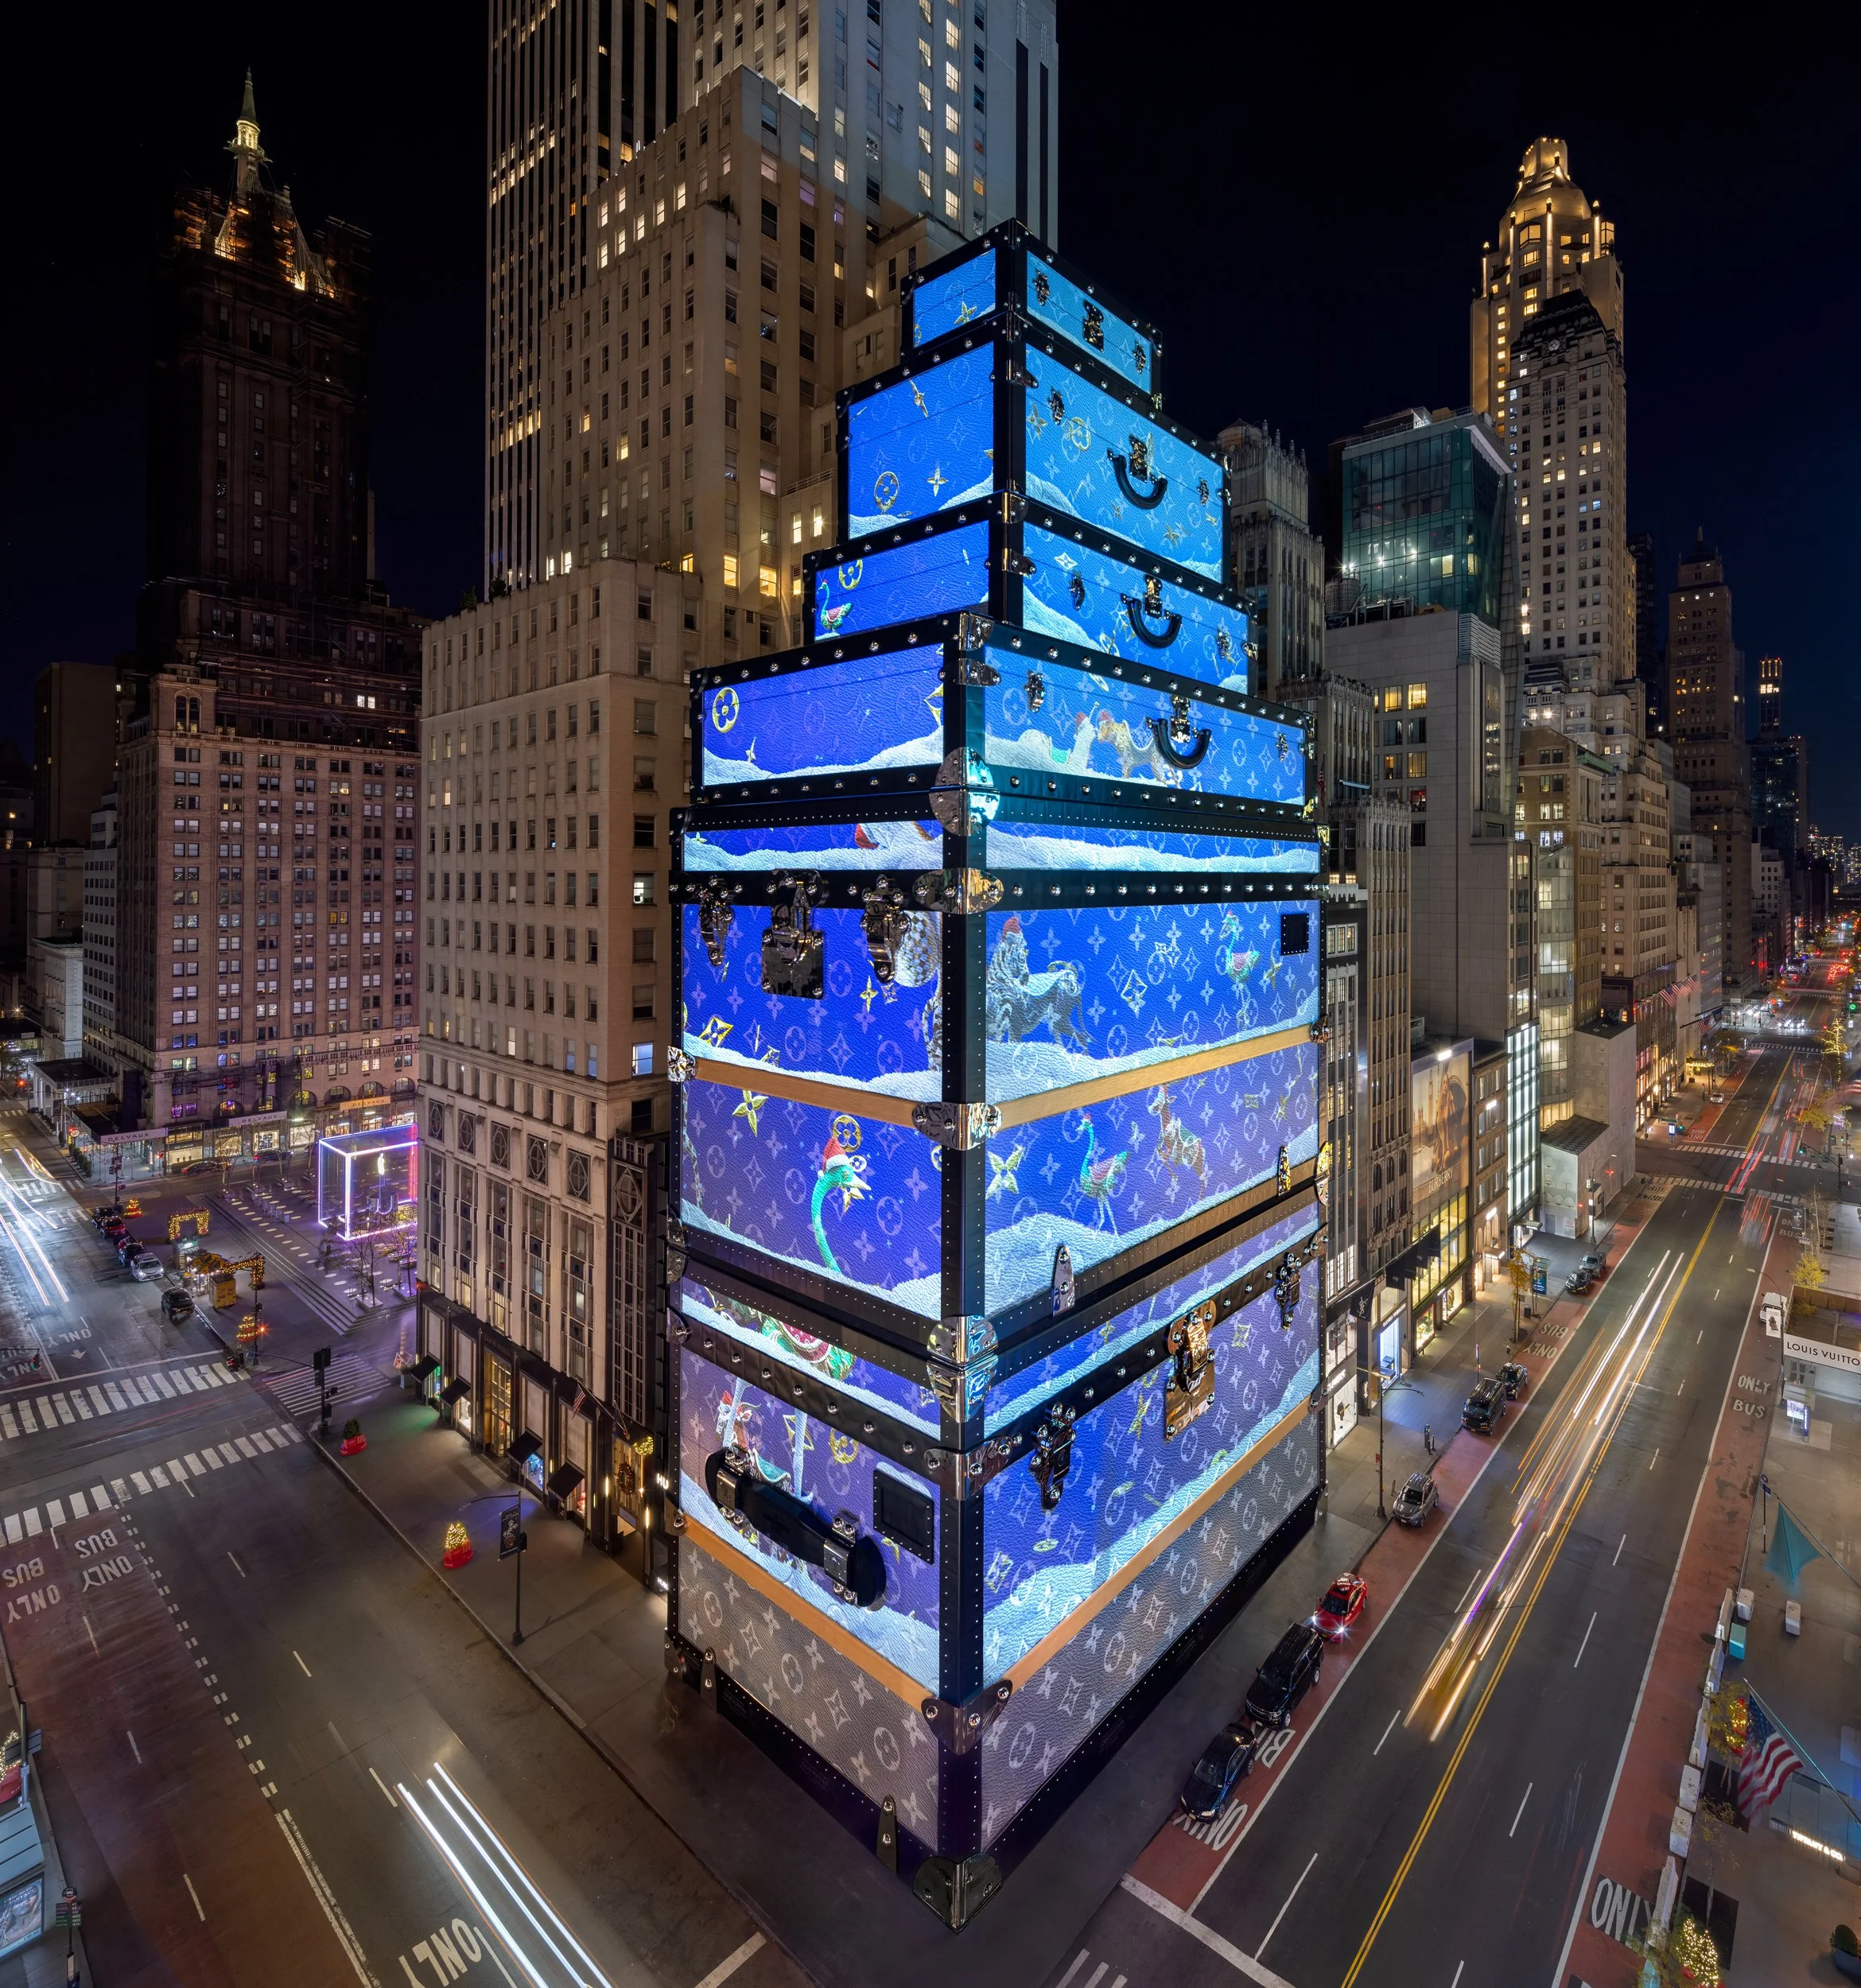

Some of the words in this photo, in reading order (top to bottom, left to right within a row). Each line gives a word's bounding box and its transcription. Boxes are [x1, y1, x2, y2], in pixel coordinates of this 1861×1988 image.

[242, 1114, 278, 1123] DELVAUX
[108, 1132, 150, 1142] DELVAUX
[1428, 1166, 1454, 1194] BURBERRY
[48, 1328, 92, 1348] ONLY
[1540, 1323, 1568, 1339] BUS
[1522, 1342, 1557, 1359] ONLY
[1787, 1342, 1818, 1356] LOUIS
[1738, 1375, 1771, 1395] ONLY
[1733, 1399, 1766, 1419] BUS
[74, 1528, 118, 1559] BUS
[2, 1557, 45, 1588] BUS
[82, 1555, 134, 1593] ONLY
[7, 1584, 60, 1623] ONLY
[1251, 1721, 1296, 1769] BU
[398, 1918, 482, 1988] ONLY
